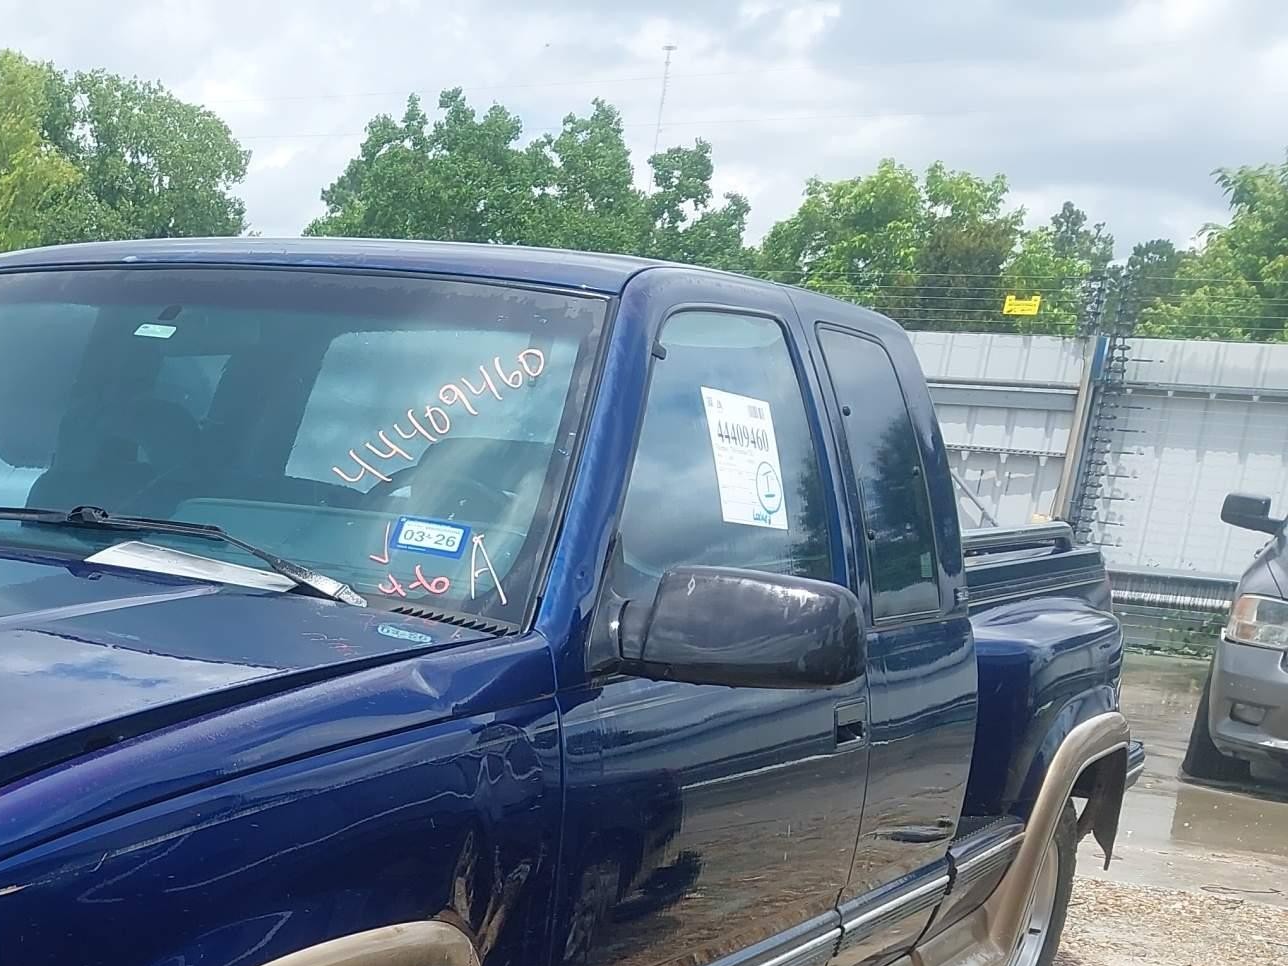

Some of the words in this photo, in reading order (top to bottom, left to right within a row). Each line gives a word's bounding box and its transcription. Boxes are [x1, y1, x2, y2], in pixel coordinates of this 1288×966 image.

[332, 348, 545, 482] 44409460
[717, 419, 770, 453] 44409460
[469, 534, 508, 606] A
